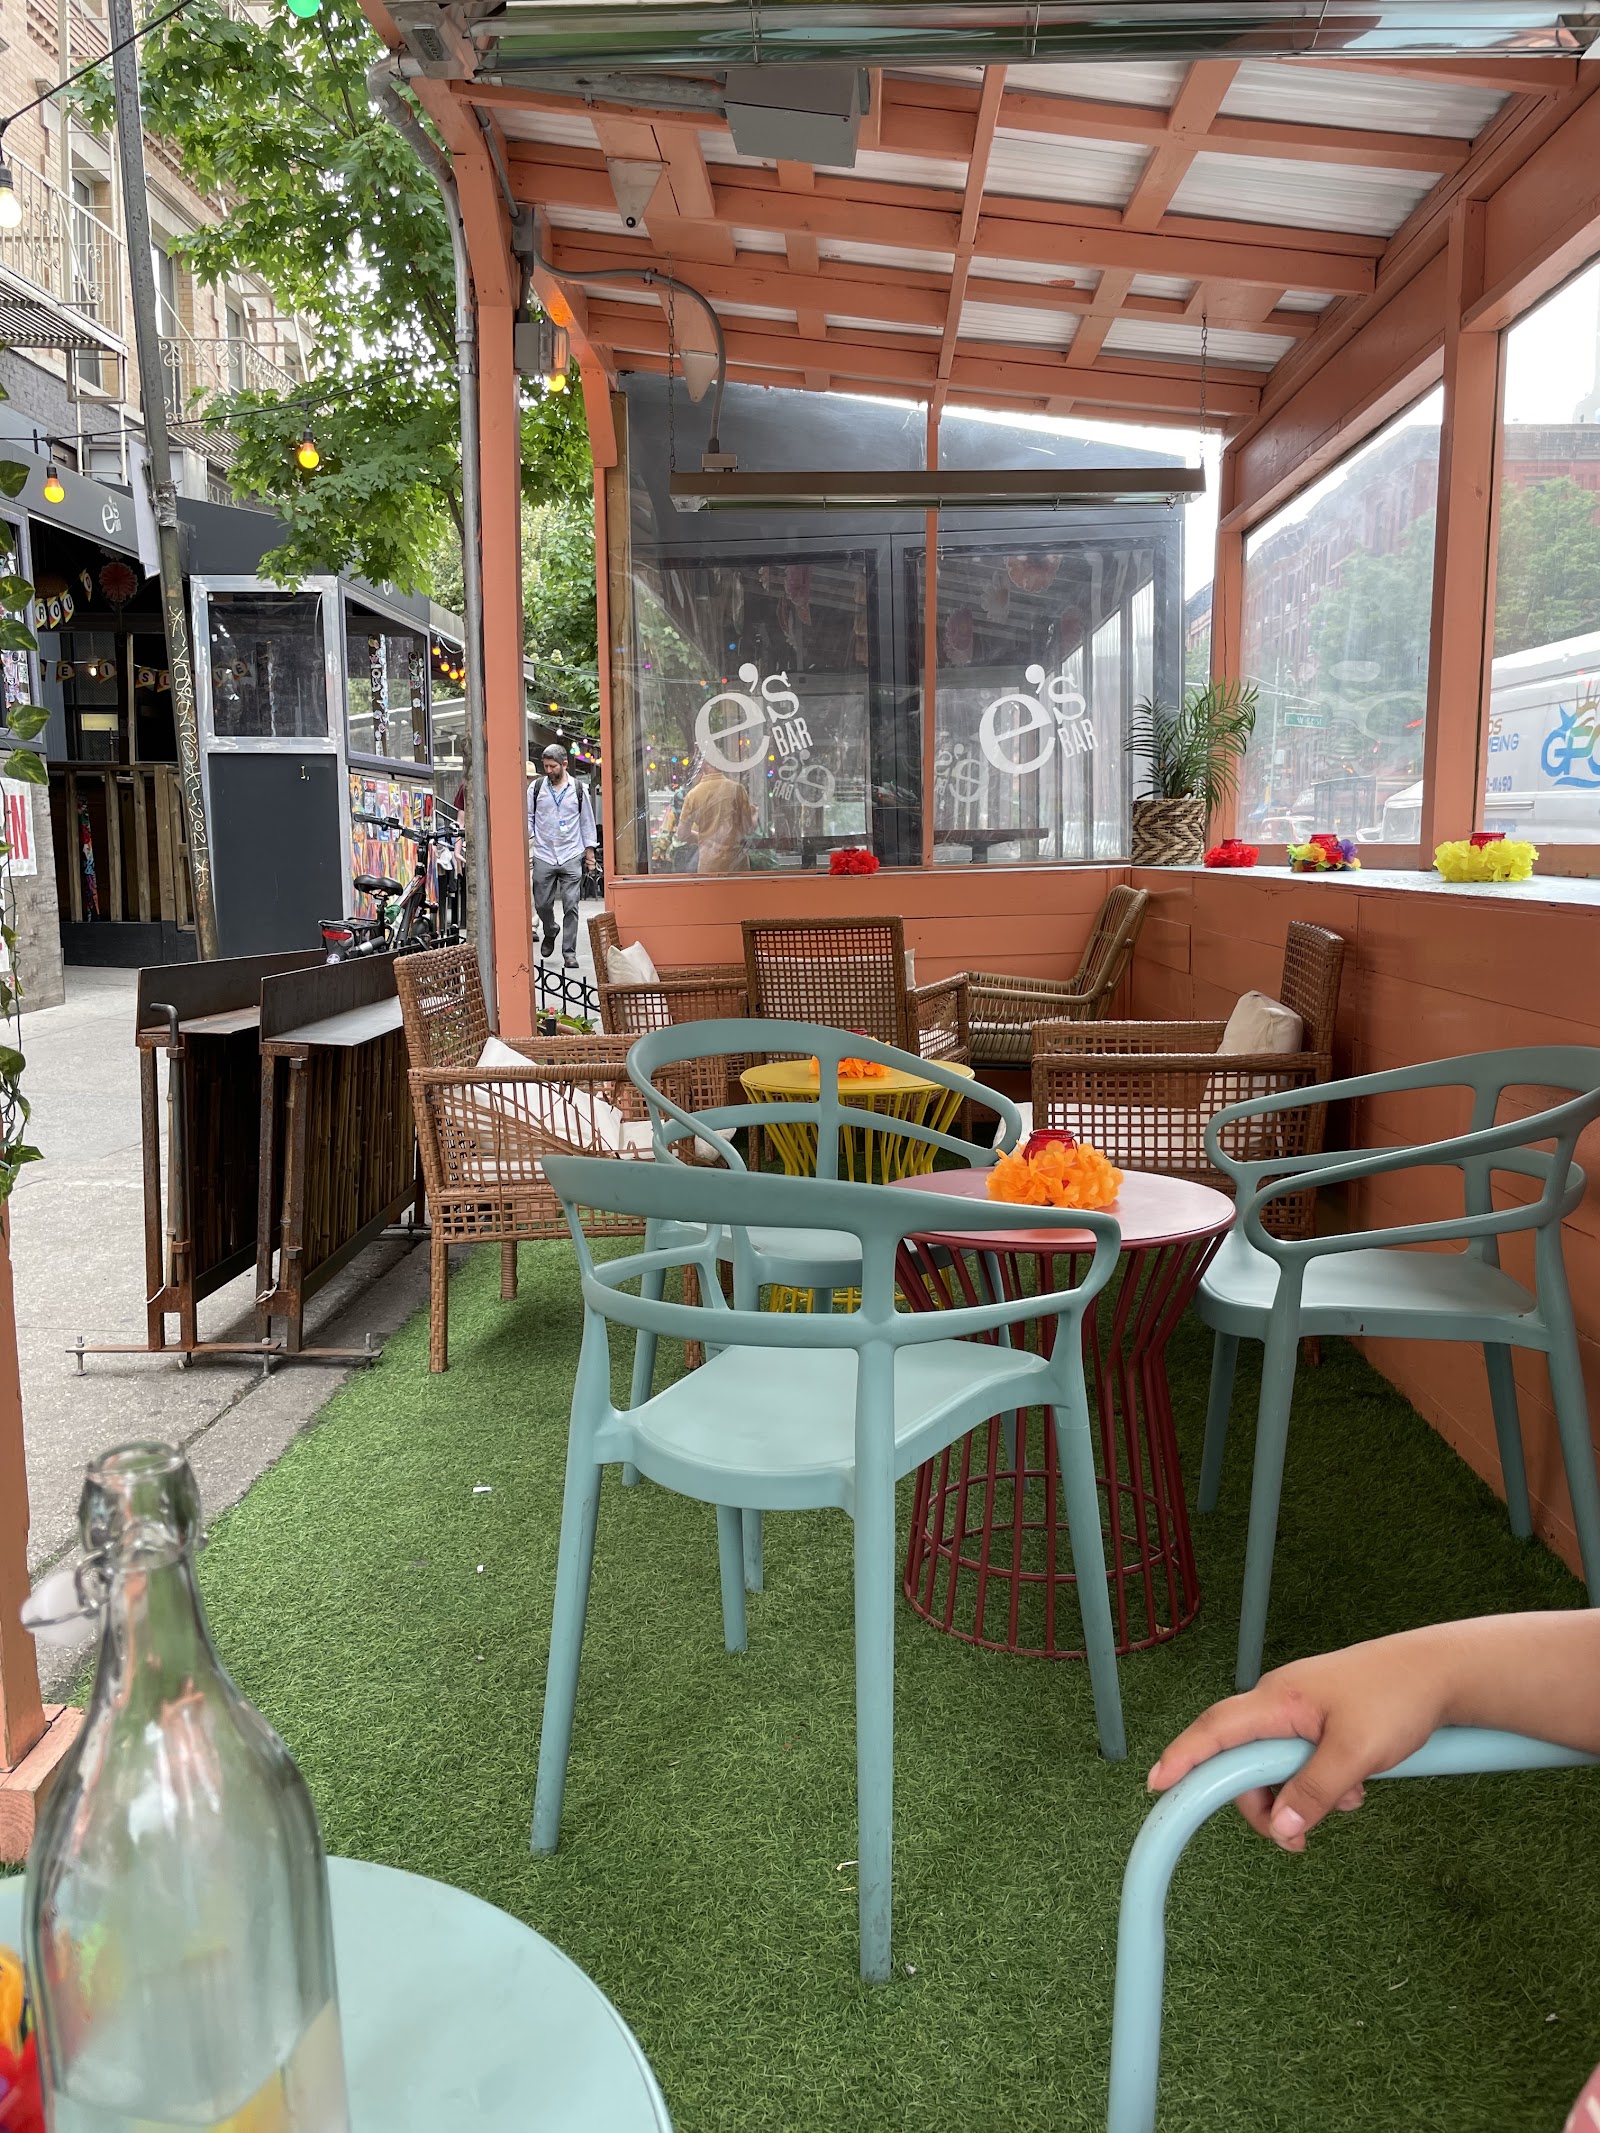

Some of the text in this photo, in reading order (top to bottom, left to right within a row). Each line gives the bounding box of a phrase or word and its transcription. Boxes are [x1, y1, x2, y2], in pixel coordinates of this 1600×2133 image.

[695, 663, 799, 772] e's
[772, 717, 813, 757] BAR
[979, 664, 1086, 774] e's
[1057, 718, 1099, 758] BAR
[188, 807, 209, 851] 2021
